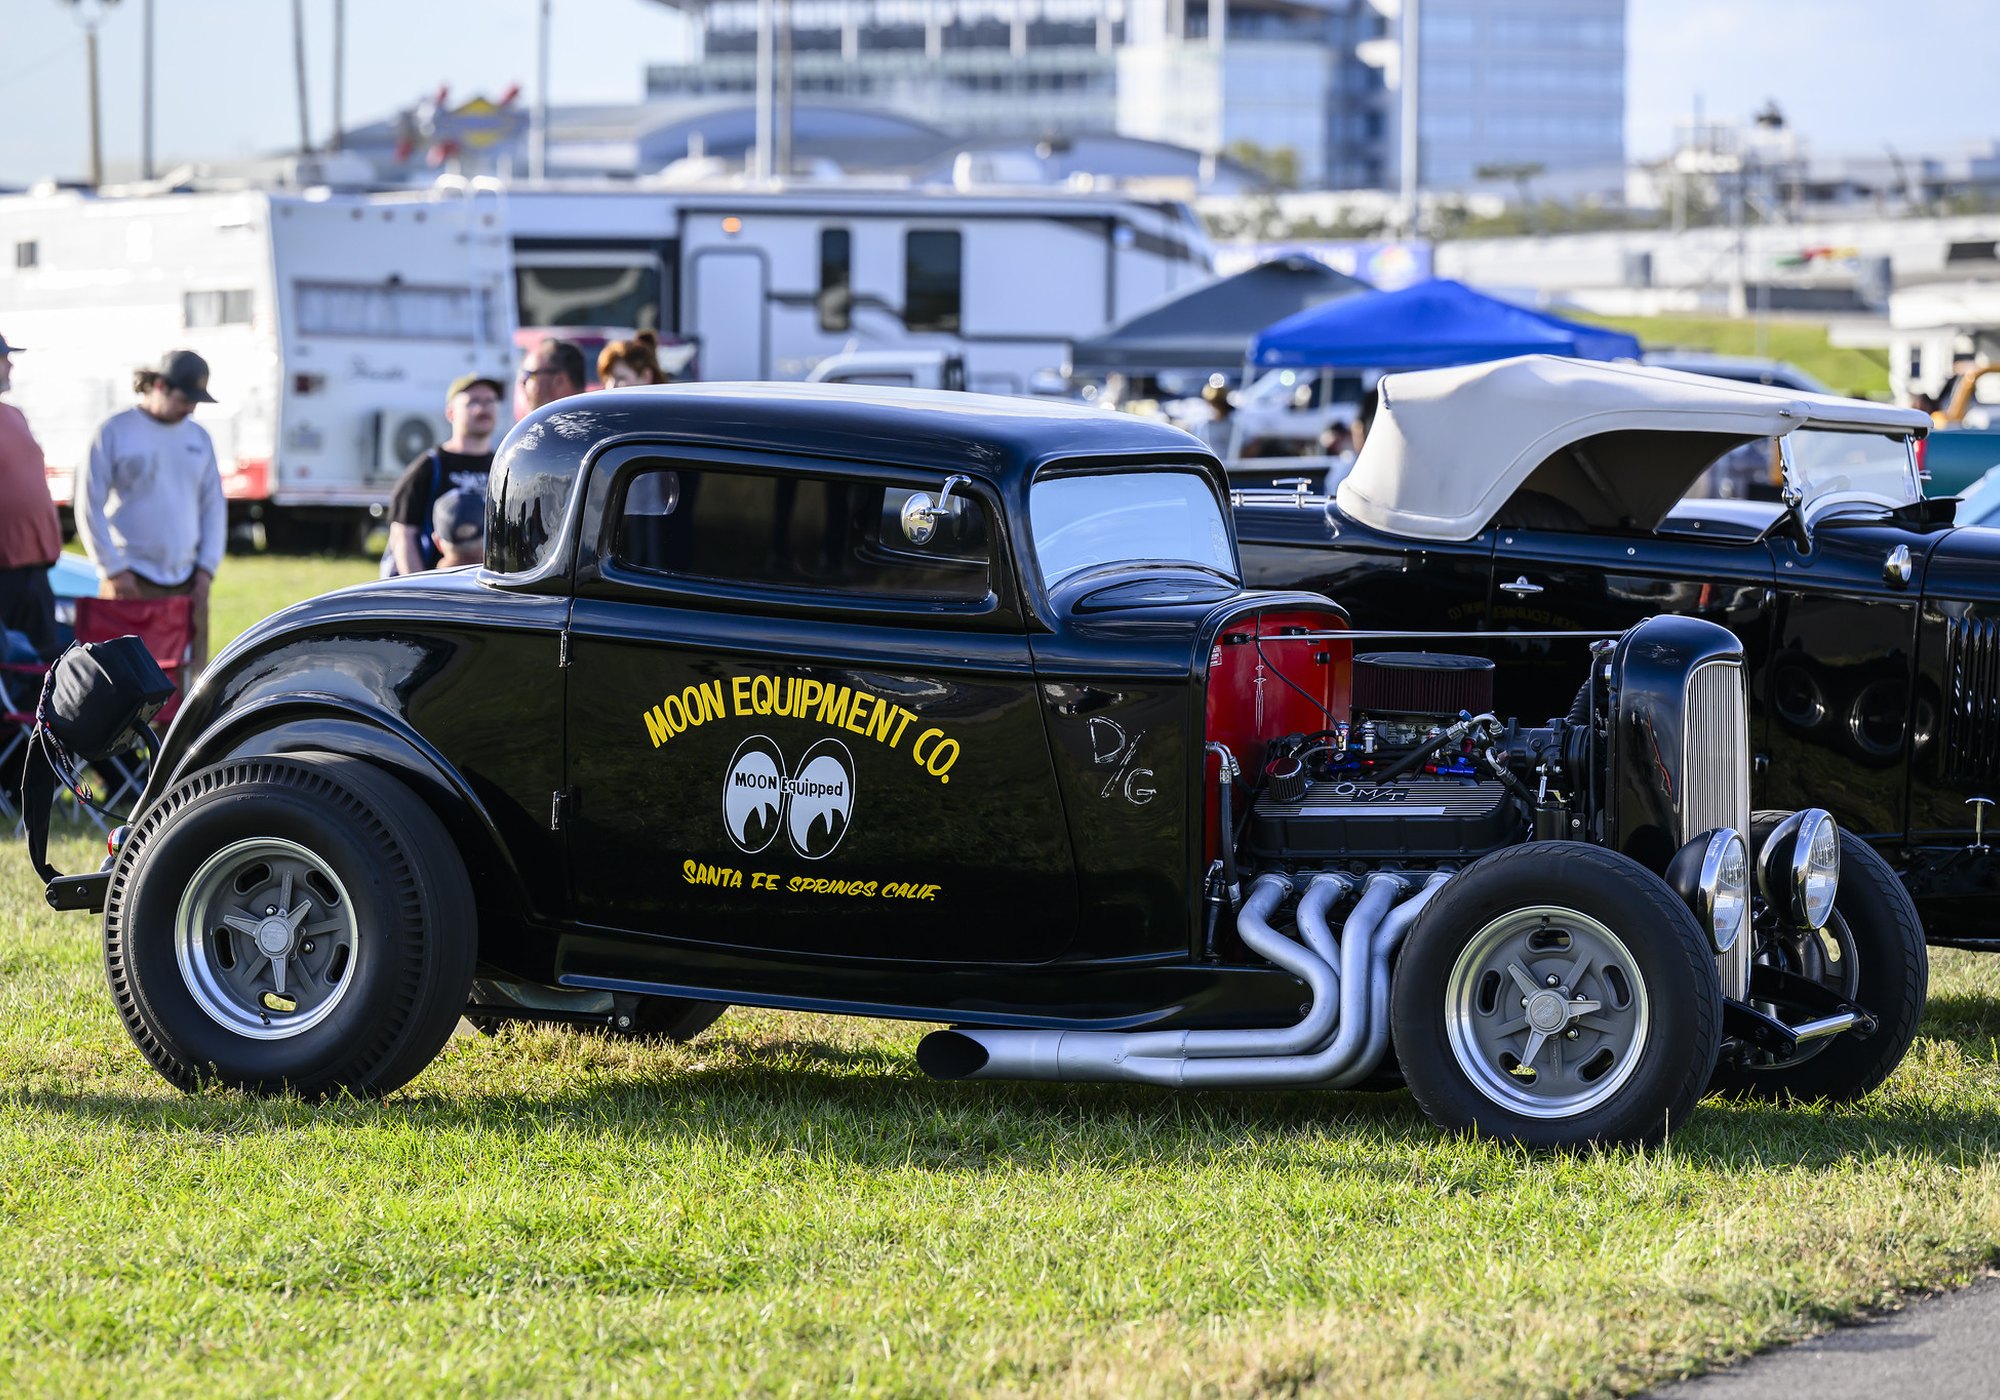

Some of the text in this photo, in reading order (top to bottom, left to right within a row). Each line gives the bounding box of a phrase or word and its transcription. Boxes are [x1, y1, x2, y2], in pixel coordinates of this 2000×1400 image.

[643, 675, 960, 784] MOON EQUIPMENT CO.
[735, 772, 844, 798] MOON Equipped
[682, 859, 743, 889] SANTA
[751, 872, 781, 891] FE
[881, 882, 942, 901] CALIF.
